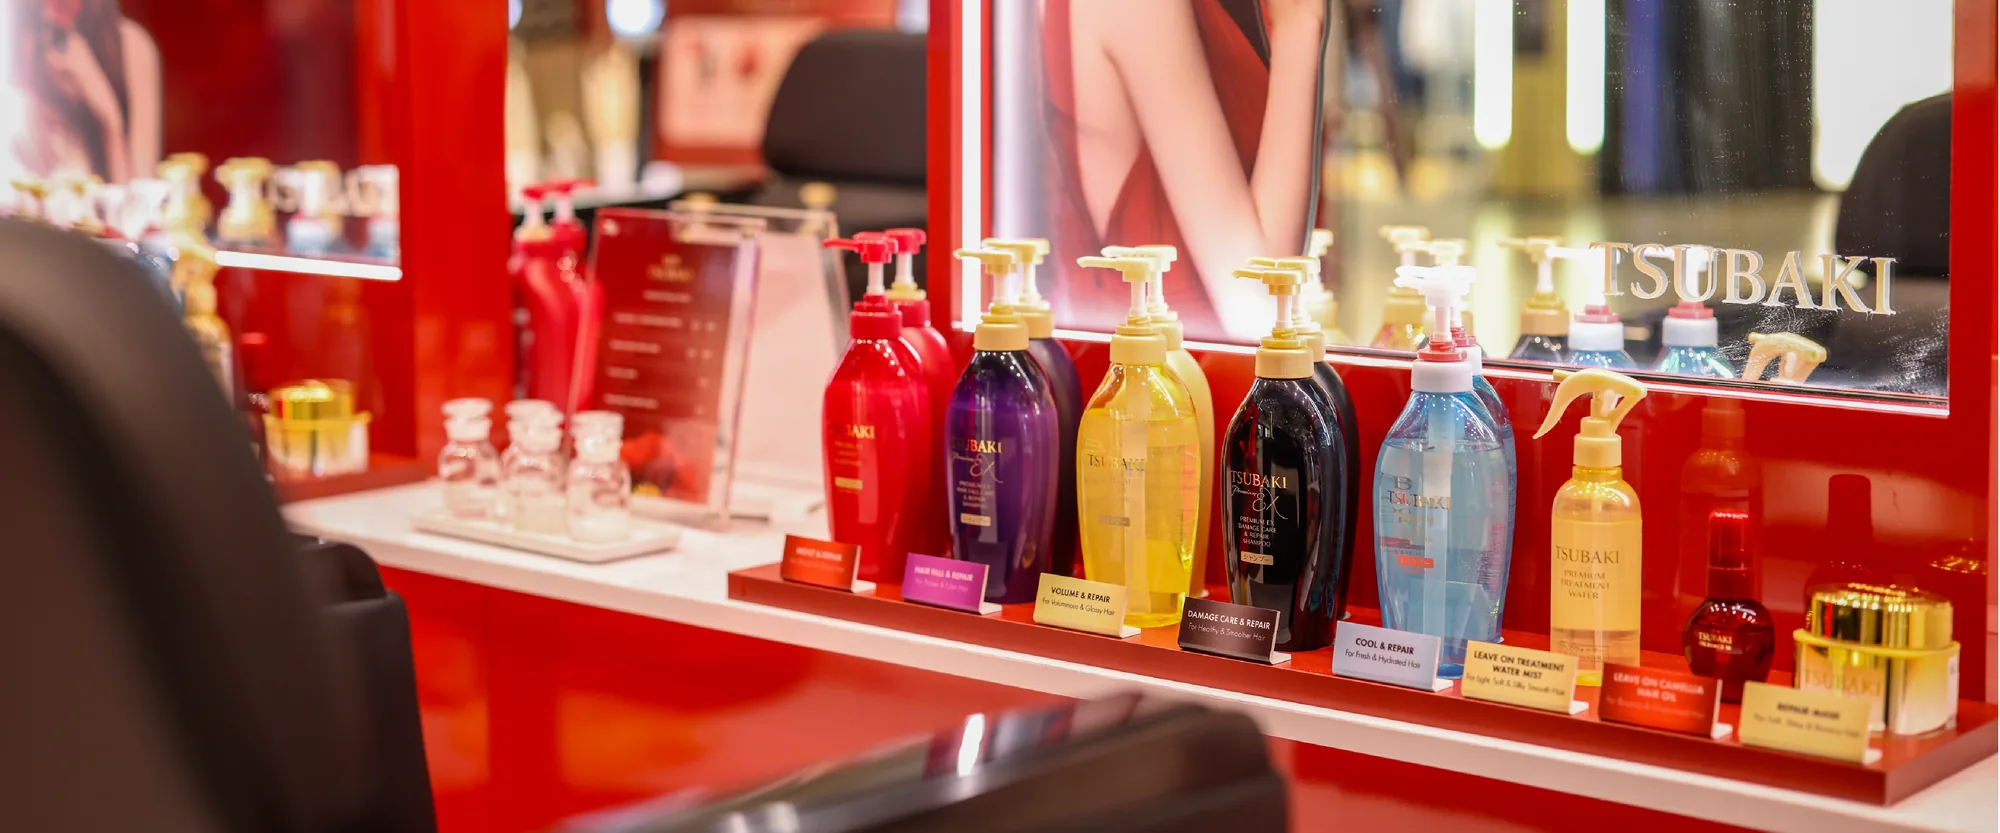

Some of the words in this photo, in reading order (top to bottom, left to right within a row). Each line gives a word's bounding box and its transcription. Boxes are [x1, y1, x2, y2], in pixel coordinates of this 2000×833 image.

[1589, 241, 1897, 315] TSUBAKI
[1231, 470, 1287, 489] TSUBAKI
[1387, 490, 1452, 510] TSUBAKI
[1238, 523, 1260, 532] DAMAGE
[1261, 526, 1276, 534] CARE
[1239, 516, 1264, 525] PREMIUM
[1242, 538, 1271, 547] SHAMPOO
[1249, 532, 1269, 540] REPAIR
[1556, 545, 1620, 564] TSUBAKI
[914, 565, 930, 576] HAIR
[930, 567, 945, 578] FALL
[945, 570, 951, 578] &
[951, 571, 974, 582] REPAIR
[1564, 570, 1605, 580] PREMIUM
[1560, 578, 1610, 590] TREATMENT
[1051, 586, 1079, 599] VOLUME
[1080, 591, 1086, 600] &
[1087, 592, 1111, 604] REPAIR
[1568, 590, 1599, 599] WATER
[1042, 597, 1050, 605] For
[1051, 598, 1079, 611] Voluminous
[1085, 604, 1103, 616] Glossy
[1103, 607, 1116, 616] Hair
[1187, 609, 1219, 622] DAMAGE
[1220, 613, 1239, 625] CARE
[1239, 617, 1245, 626] &
[1246, 618, 1271, 630] REPAIR
[1188, 622, 1198, 630] For
[1198, 623, 1219, 635] Healthy
[1219, 627, 1225, 635] &
[1253, 632, 1267, 642] Hair
[1355, 637, 1378, 650] COOL
[1379, 642, 1386, 650] &
[1387, 643, 1415, 655] REPAIR
[1345, 648, 1355, 658] For
[1356, 649, 1371, 661] Fresh
[1372, 653, 1378, 661] &
[1378, 654, 1407, 668] Hydrated
[1408, 659, 1421, 669] Hair
[1473, 650, 1499, 661] LEAVE
[1500, 654, 1515, 664] ON
[1516, 657, 1564, 673] TREATMENT
[1492, 665, 1521, 677] WATER
[1522, 669, 1542, 680] MIST
[1613, 672, 1640, 686] LEAVE
[1641, 675, 1658, 687] ON
[1637, 687, 1659, 700] HAIR
[1660, 690, 1676, 703] OIL
